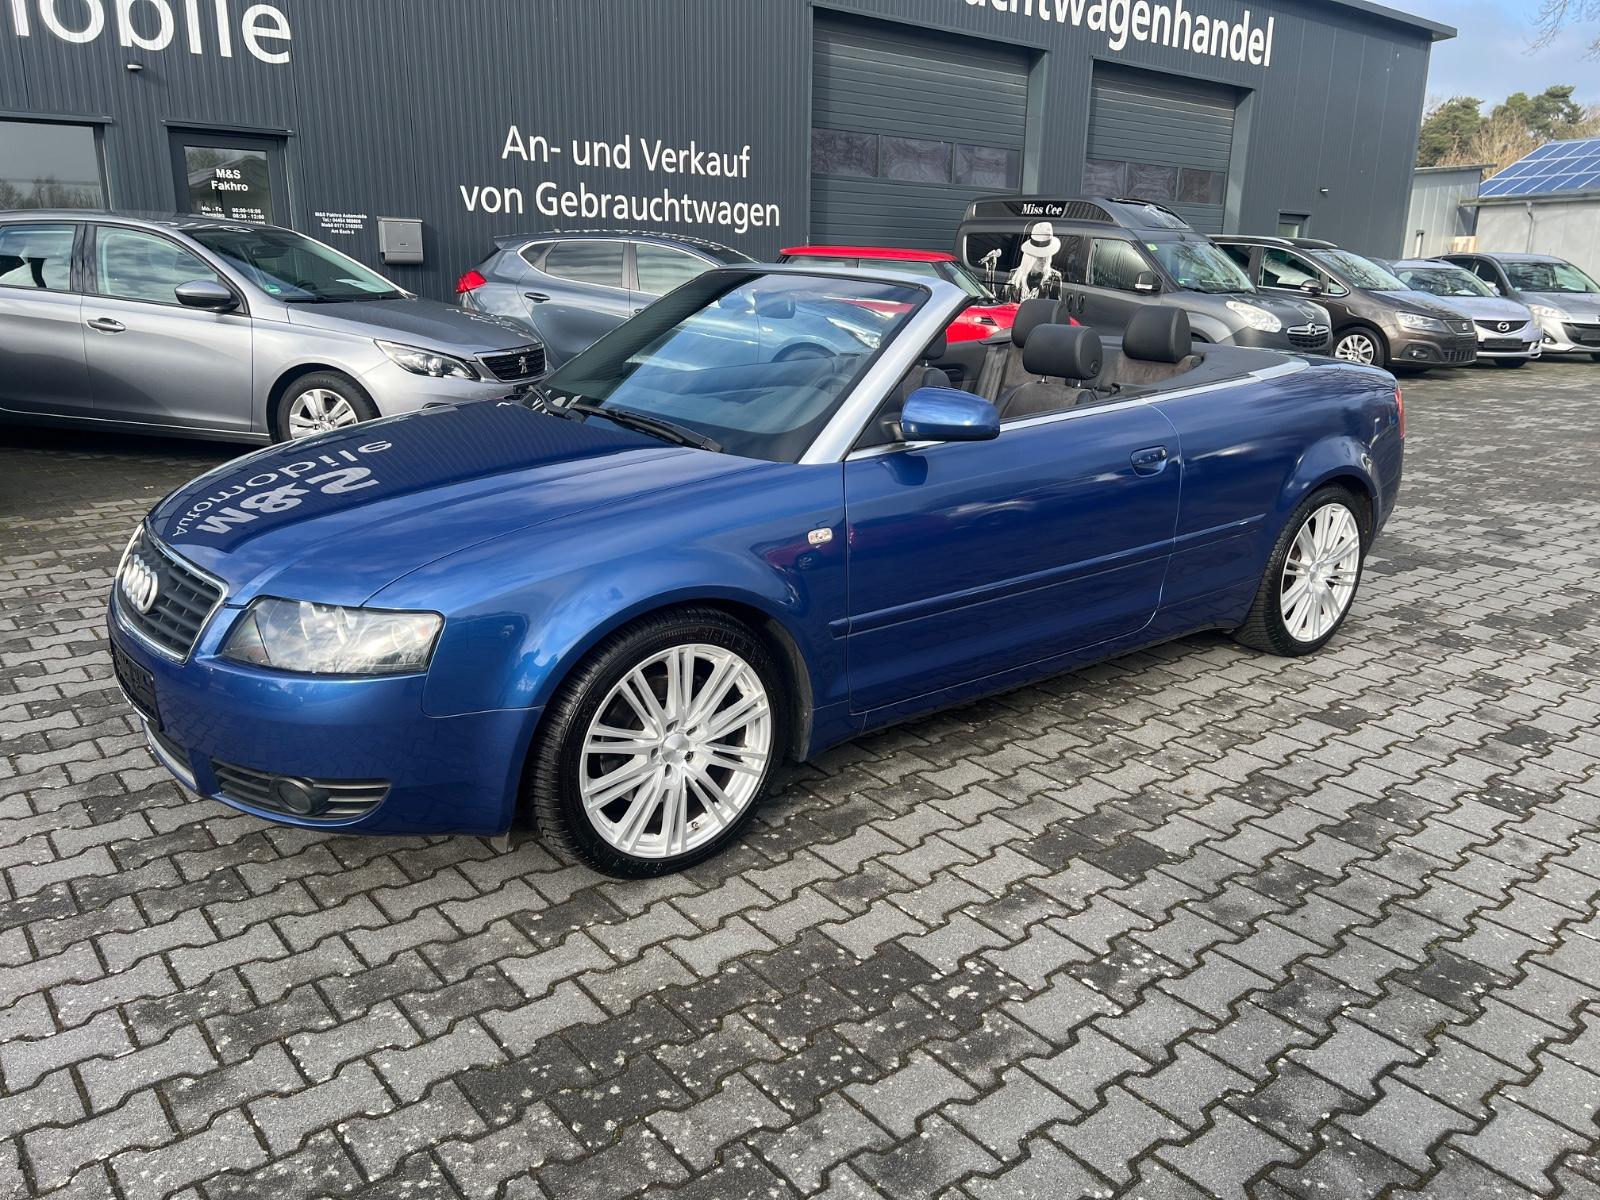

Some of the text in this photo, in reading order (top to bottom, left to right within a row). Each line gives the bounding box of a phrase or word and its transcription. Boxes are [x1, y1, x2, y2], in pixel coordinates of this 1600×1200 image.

[10, 0, 291, 64] obile
[502, 125, 751, 178] An- und Verkauf
[211, 180, 249, 191] Fakhro
[215, 168, 241, 179] M&S
[460, 182, 780, 234] von Gebrauchtwagen
[1021, 203, 1063, 215] Miss Cee
